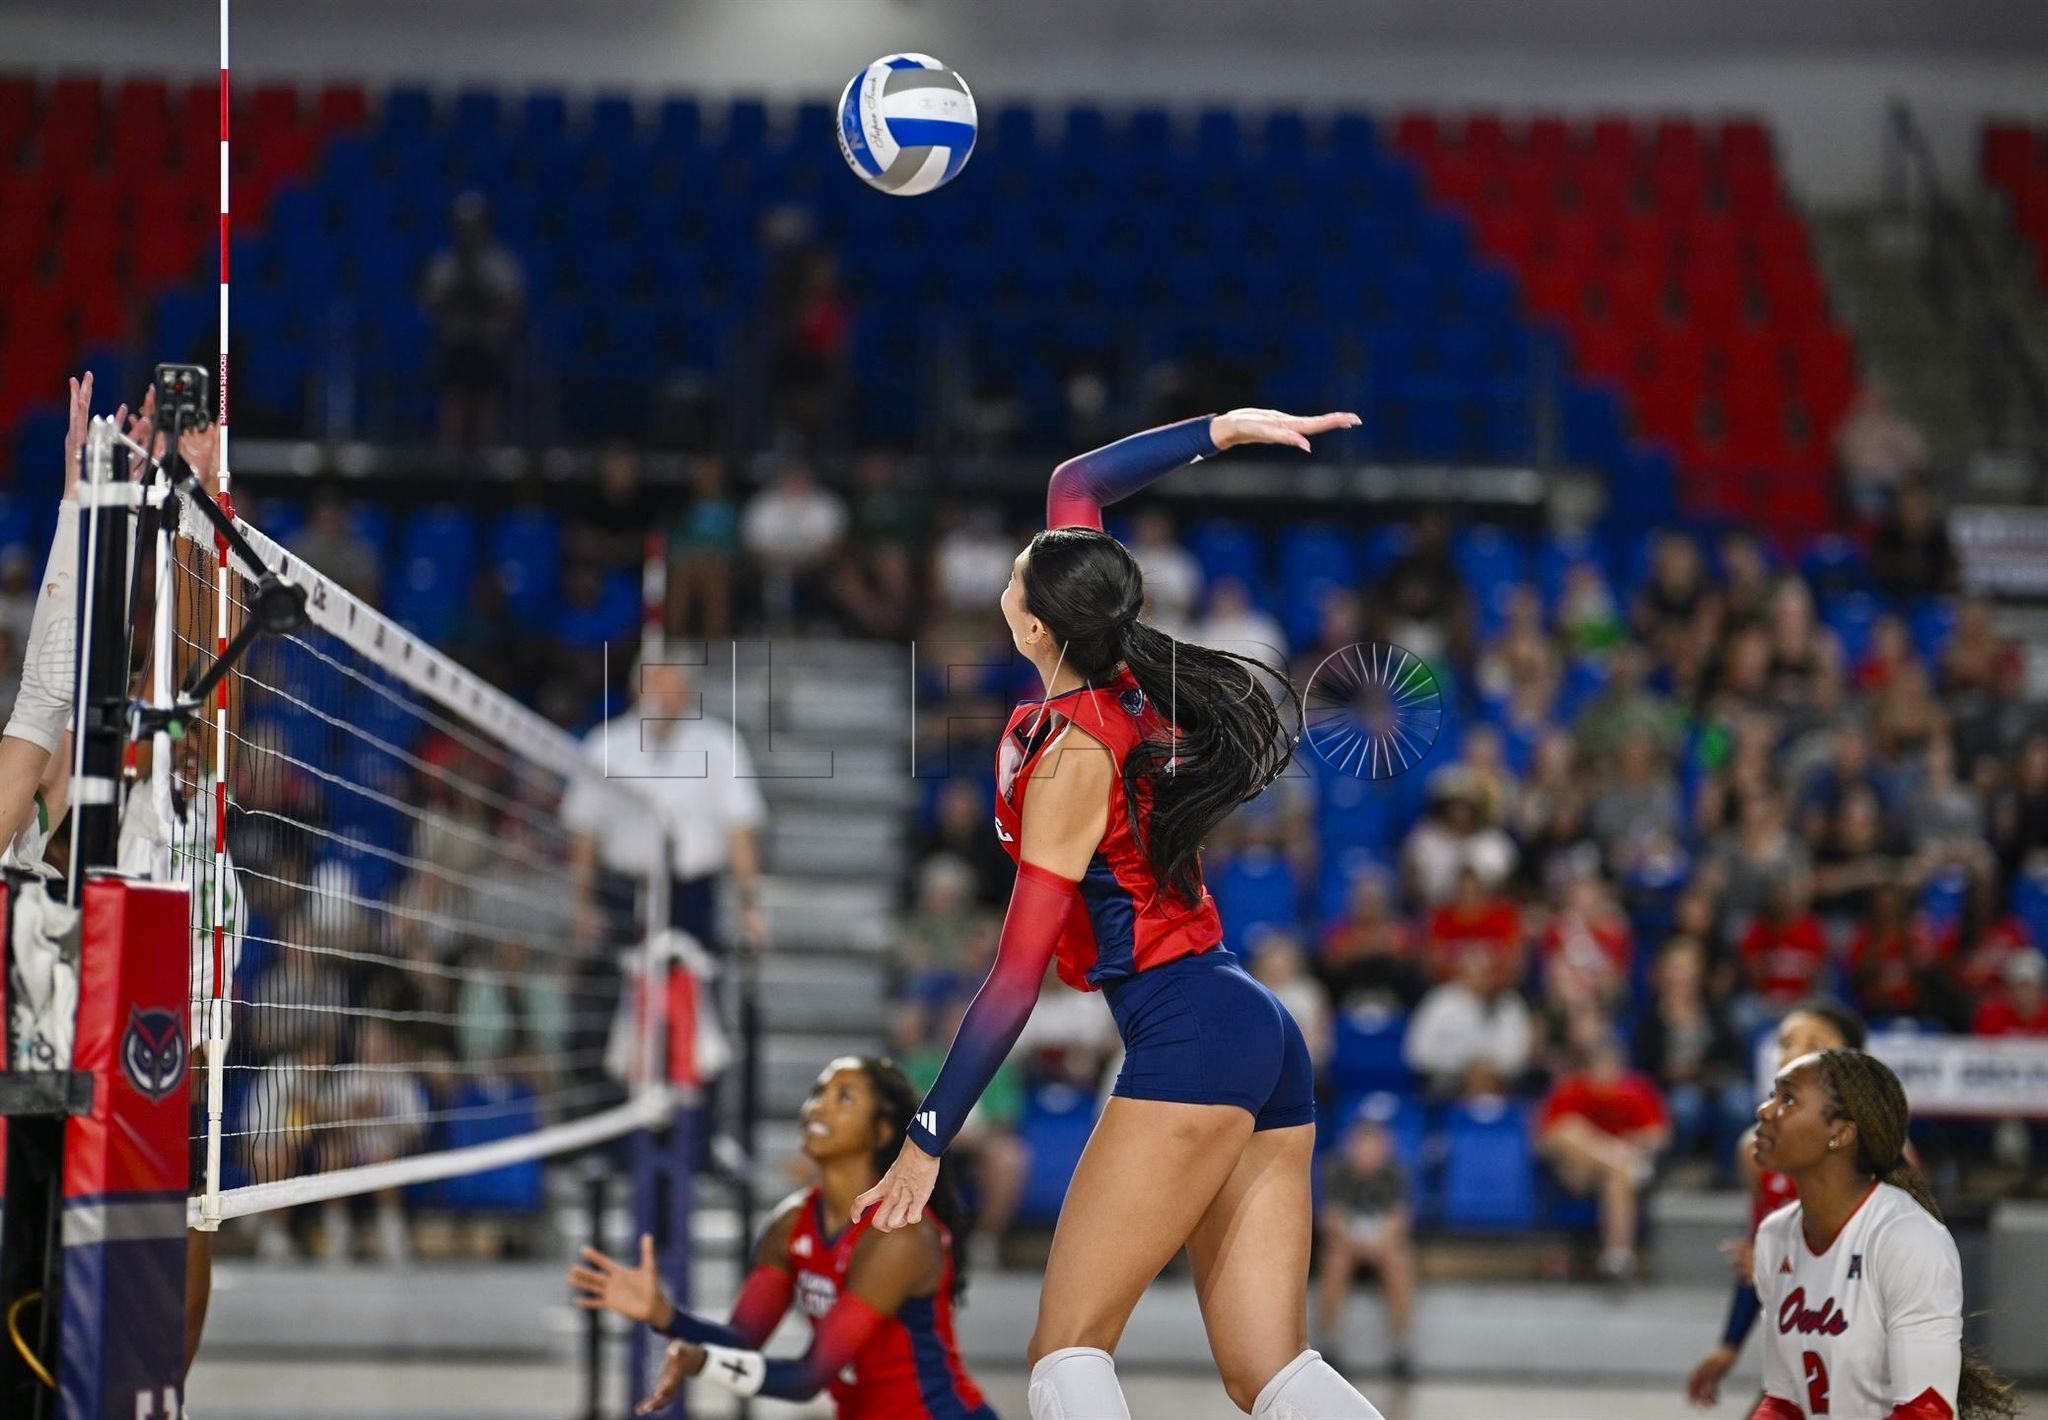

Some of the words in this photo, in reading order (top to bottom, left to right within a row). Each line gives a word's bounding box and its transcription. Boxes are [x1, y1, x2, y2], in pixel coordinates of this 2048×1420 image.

[220, 354, 228, 385] sports
[220, 386, 228, 424] imports
[1778, 1286, 1849, 1337] Owls
[1802, 1350, 1830, 1415] 2
